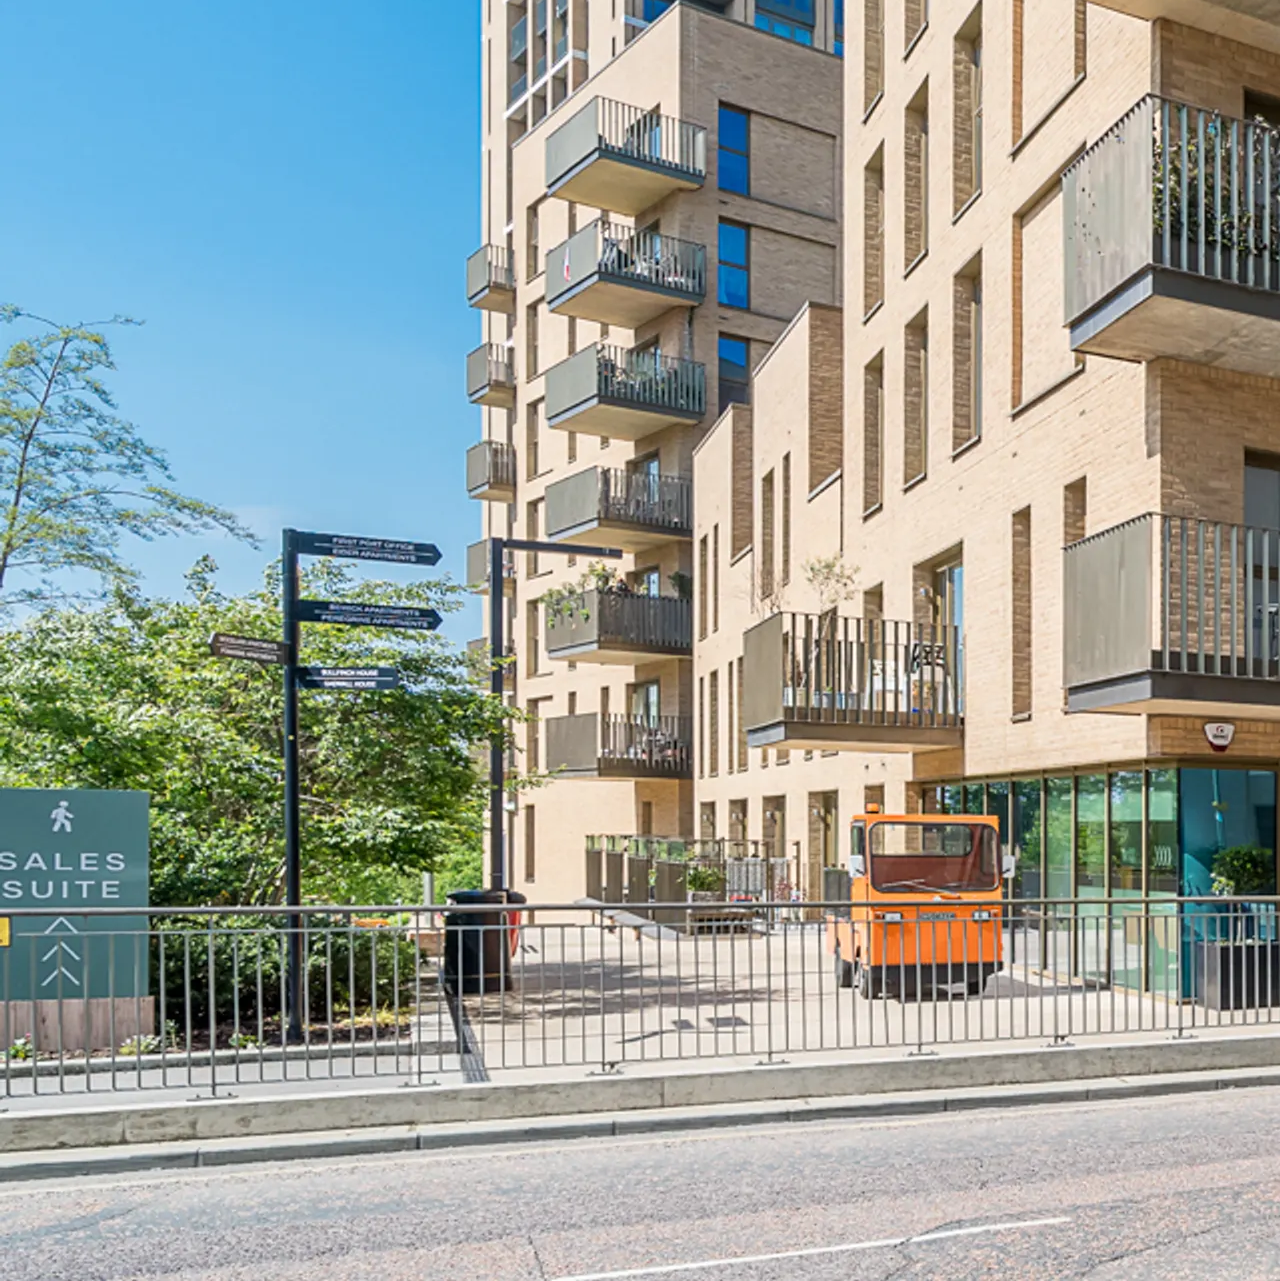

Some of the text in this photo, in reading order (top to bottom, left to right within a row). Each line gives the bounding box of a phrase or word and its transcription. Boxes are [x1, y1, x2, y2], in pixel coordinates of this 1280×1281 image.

[331, 537, 416, 551] FIRST PORT OFFICE
[360, 551, 417, 562] APARTMENTS
[364, 606, 420, 617] APARTMENTS
[321, 614, 429, 628] PEREGRINE APARTMENTS
[354, 680, 377, 688] HOUSE
[0, 851, 126, 871] SALES
[2, 879, 121, 899] SUITE
